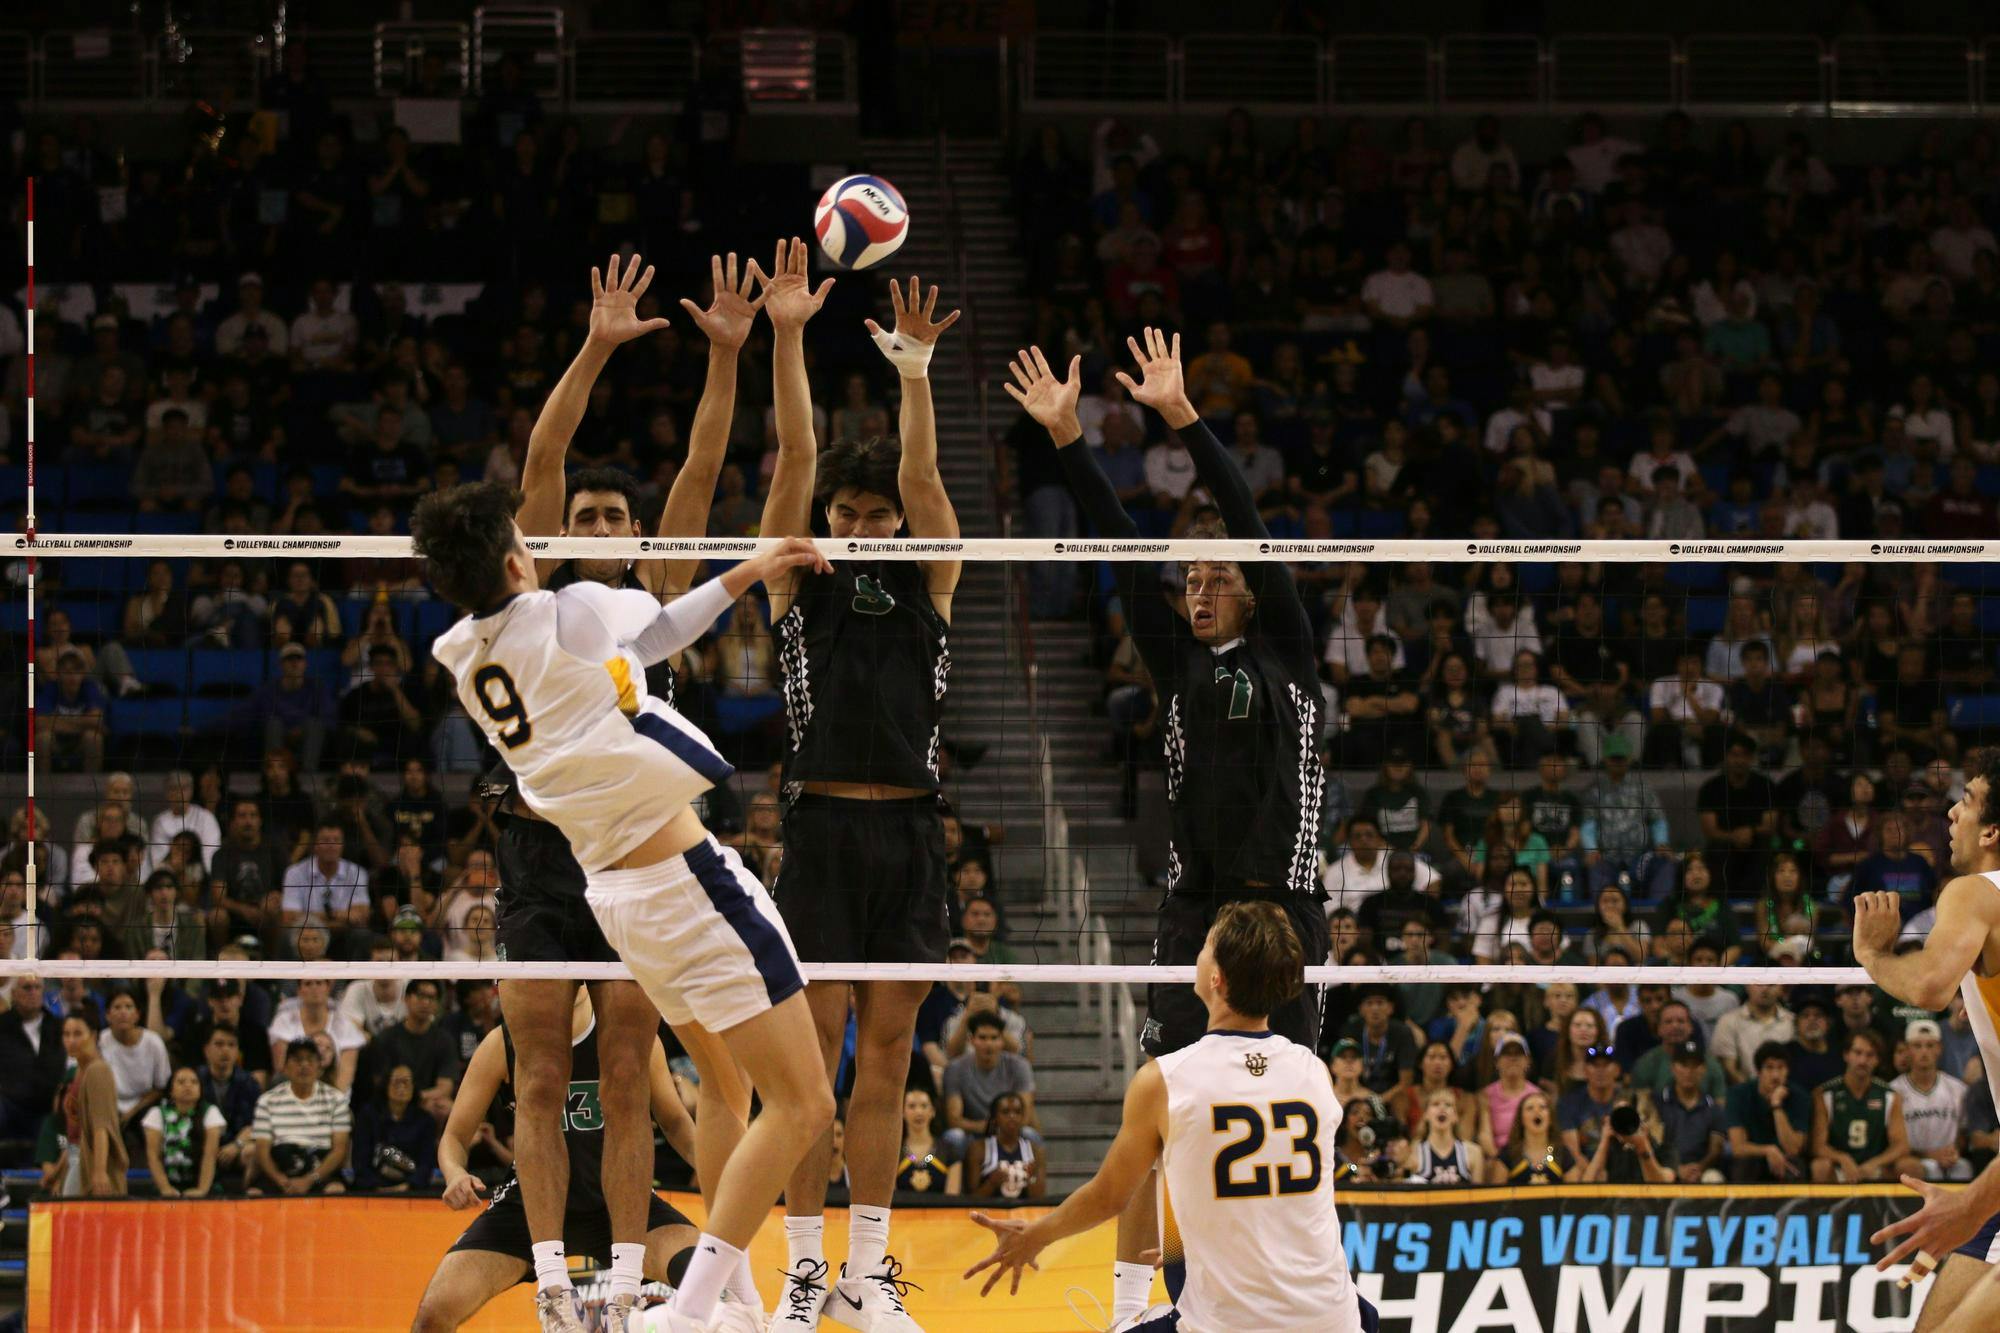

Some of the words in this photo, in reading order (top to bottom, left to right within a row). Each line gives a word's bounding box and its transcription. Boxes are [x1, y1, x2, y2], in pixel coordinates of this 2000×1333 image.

[27, 540, 72, 548] VOLLEYBALL
[73, 540, 133, 549] CHAMPIONSHIP
[236, 541, 280, 549] VOLLEYBALL
[282, 541, 341, 549] CHAMPIONSHIP
[652, 542, 696, 551] VOLLEYBALL
[698, 542, 757, 552] CHAMPIONSHIP
[859, 543, 903, 552] VOLLEYBALL
[905, 543, 963, 552] CHAMPIONSHIP
[1066, 544, 1109, 552] VOLLEYBALL
[1111, 544, 1170, 553] CHAMPIONSHIP
[1271, 545, 1315, 553] VOLLEYBALL
[1316, 545, 1375, 553] CHAMPIONSHIP
[1479, 545, 1522, 554] VOLLEYBALL
[1523, 545, 1581, 554] CHAMPIONSHIP
[1681, 545, 1724, 554] VOLLEYBALL
[1726, 545, 1784, 554] CHAMPIONSHIP
[1882, 545, 1925, 554] VOLLEYBALL
[1927, 545, 1985, 554] CHAMPIONSHIP
[473, 663, 532, 752] 9
[560, 1080, 606, 1131] 3
[1848, 1119, 1868, 1149] 9
[1210, 1098, 1322, 1200] 23
[1341, 1220, 1432, 1273] N'S
[1446, 1216, 1524, 1271] NC
[1540, 1213, 1870, 1267] VOLLEYBALL
[1356, 1264, 1937, 1333] HAMPIO
